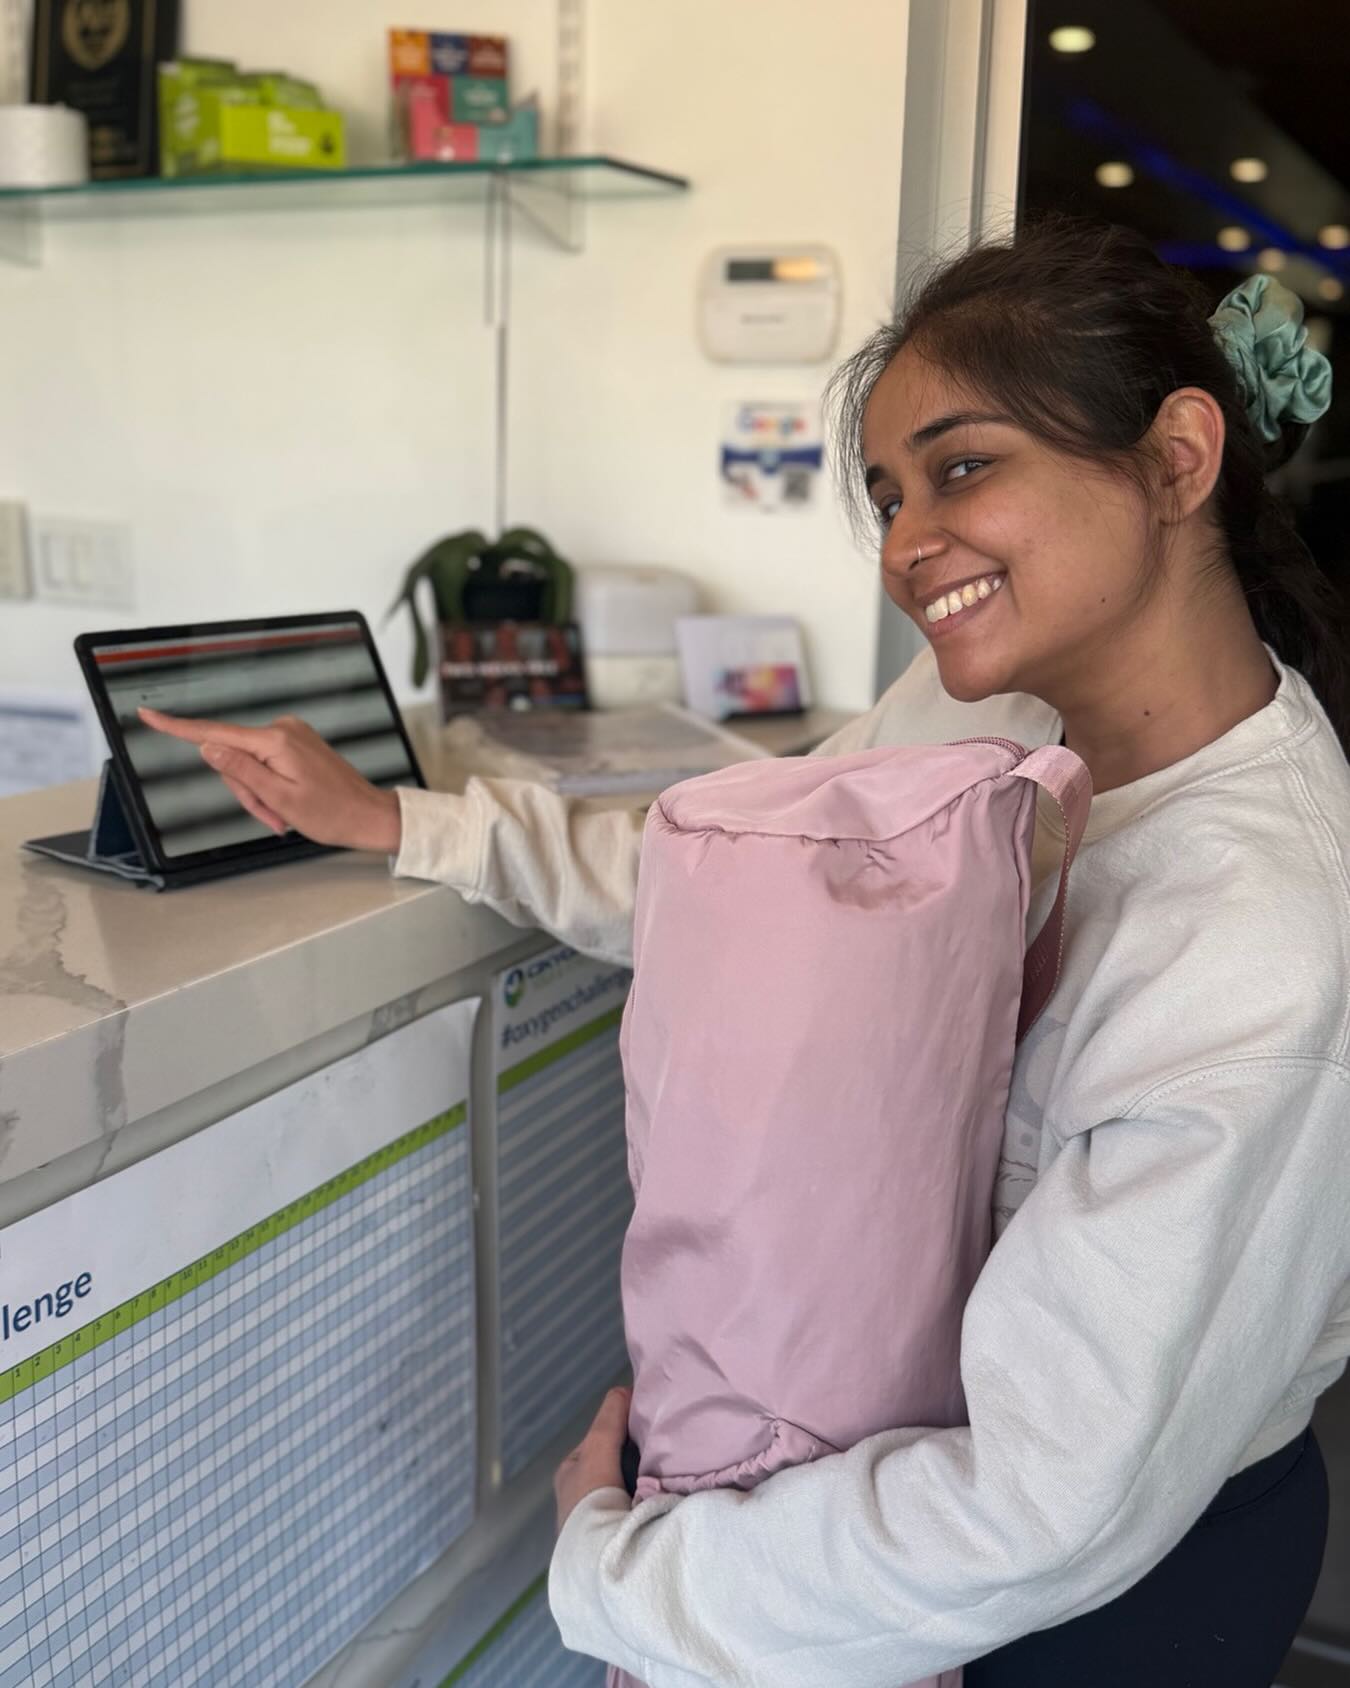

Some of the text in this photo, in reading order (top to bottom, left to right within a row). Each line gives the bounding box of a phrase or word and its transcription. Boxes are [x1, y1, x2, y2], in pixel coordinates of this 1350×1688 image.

[15, 1367, 21, 1378] 1
[34, 1356, 41, 1367] 2
[55, 1344, 62, 1355] 3
[75, 1332, 81, 1343] 4
[95, 1321, 102, 1331] 5
